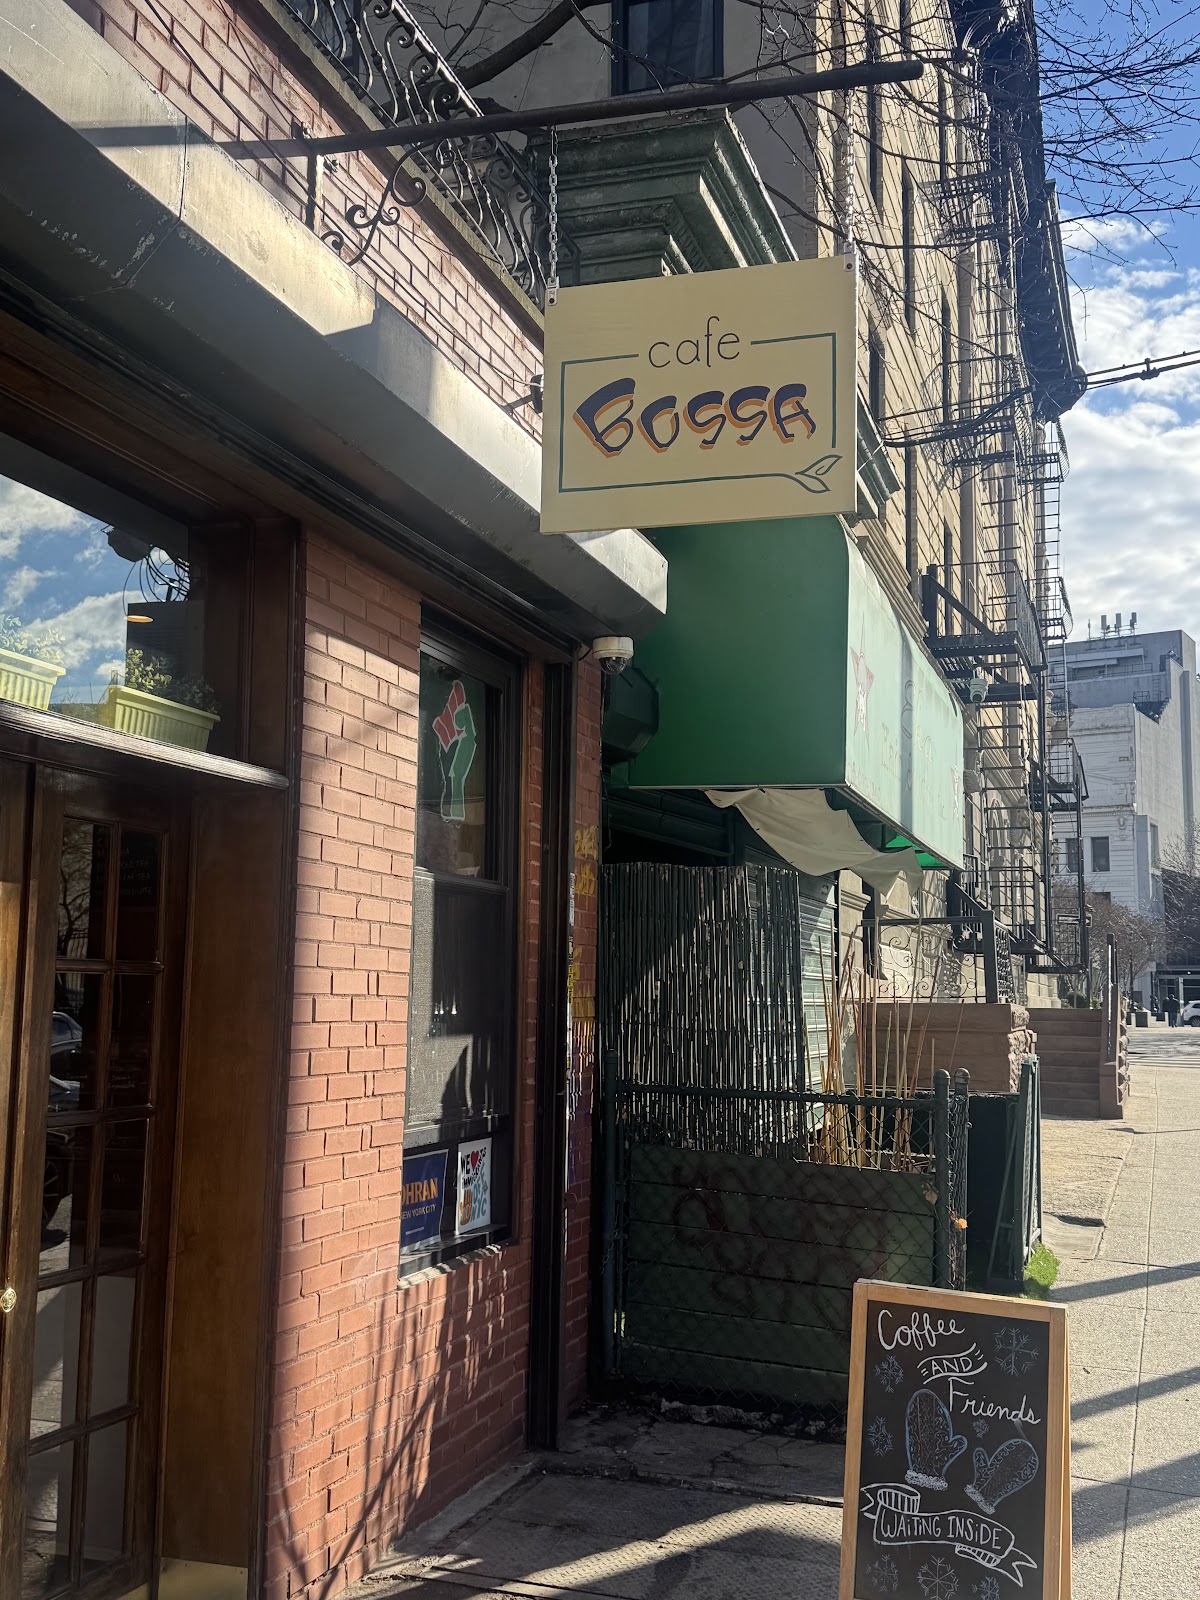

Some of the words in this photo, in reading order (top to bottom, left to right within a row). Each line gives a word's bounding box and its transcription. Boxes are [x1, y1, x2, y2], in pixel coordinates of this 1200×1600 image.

[648, 316, 740, 368] cafe
[572, 377, 816, 458] BOSSA
[461, 1154, 470, 1175] WE
[412, 1206, 425, 1217] YORK
[425, 1203, 437, 1214] CITY
[878, 1309, 965, 1351] Coffee
[931, 1356, 973, 1375] AND
[948, 1377, 1041, 1424] Friends
